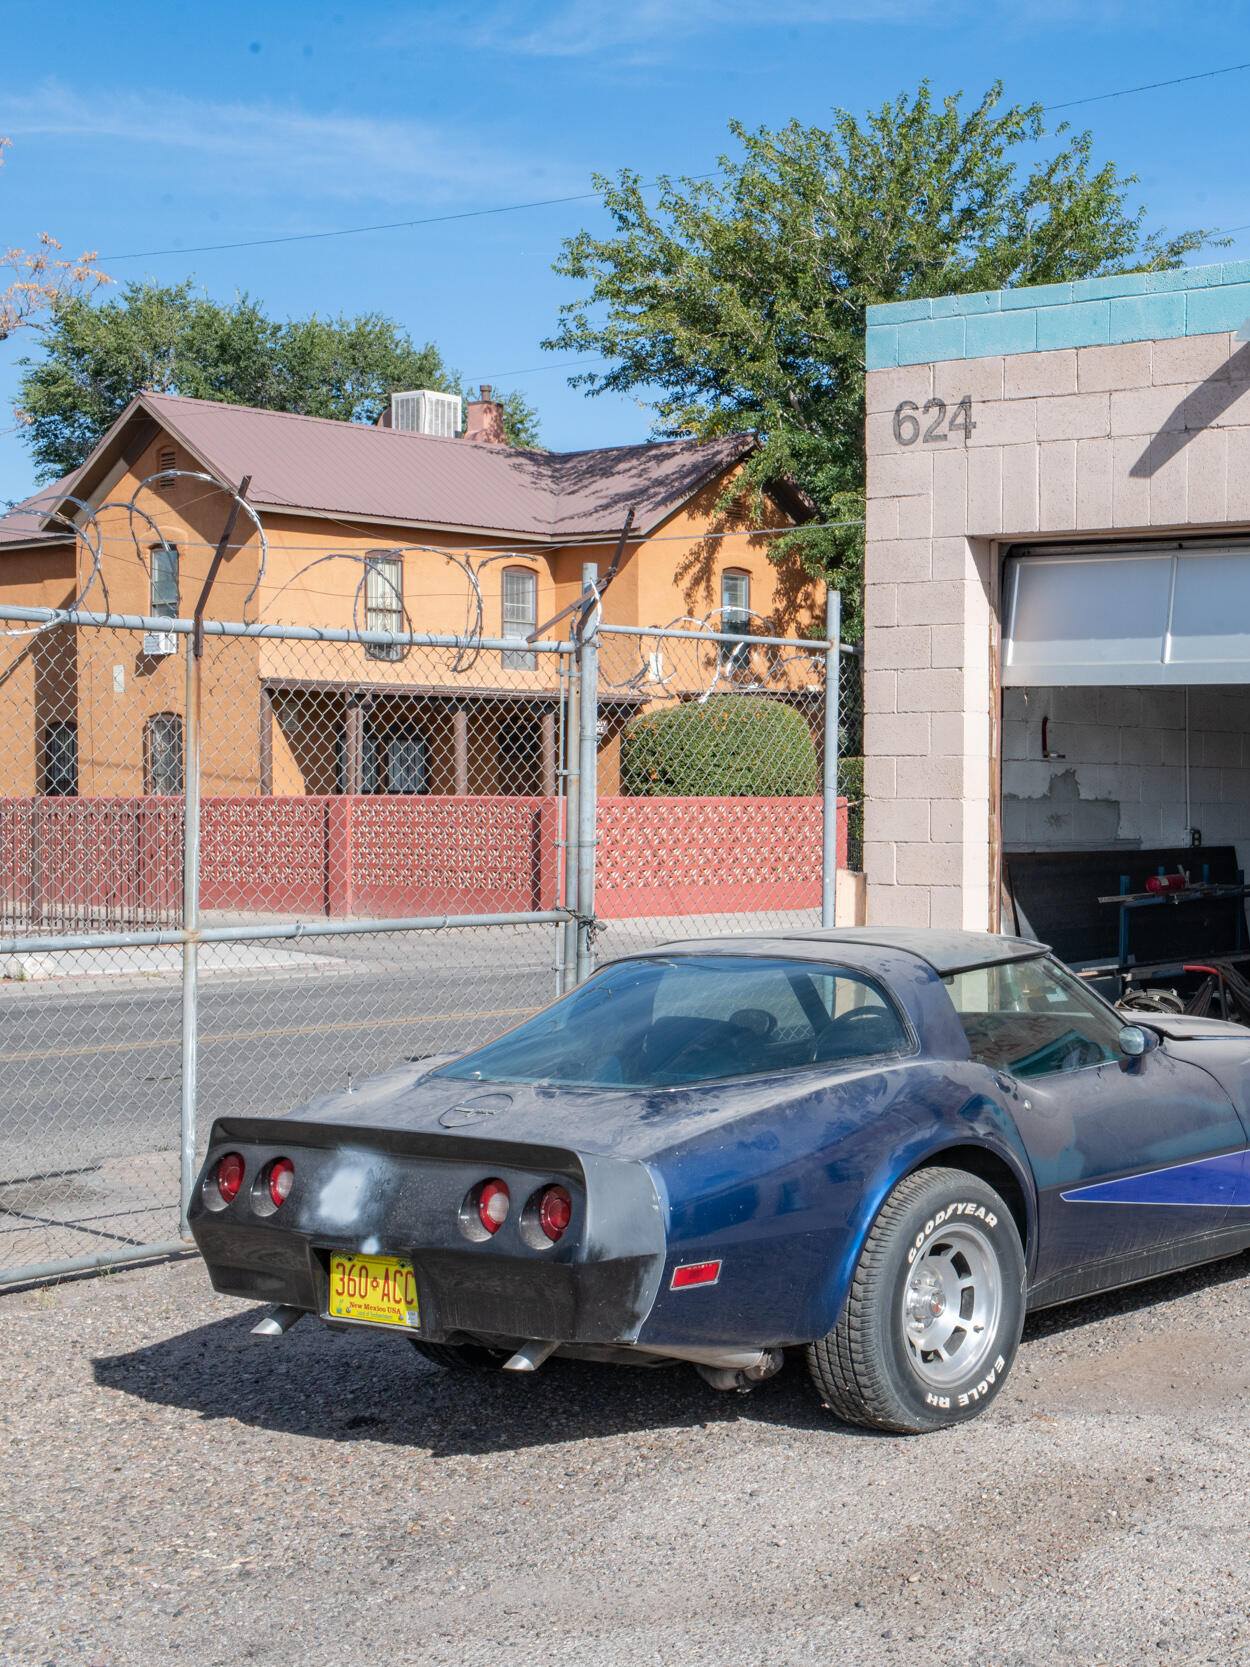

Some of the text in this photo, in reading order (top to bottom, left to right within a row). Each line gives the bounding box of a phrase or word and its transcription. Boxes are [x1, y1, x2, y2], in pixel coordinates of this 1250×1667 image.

[893, 394, 976, 446] 624
[908, 1203, 998, 1264] GOODYEAR
[363, 1303, 386, 1313] Mexico
[387, 1306, 401, 1315] USA
[958, 1354, 1005, 1408] EAGLE
